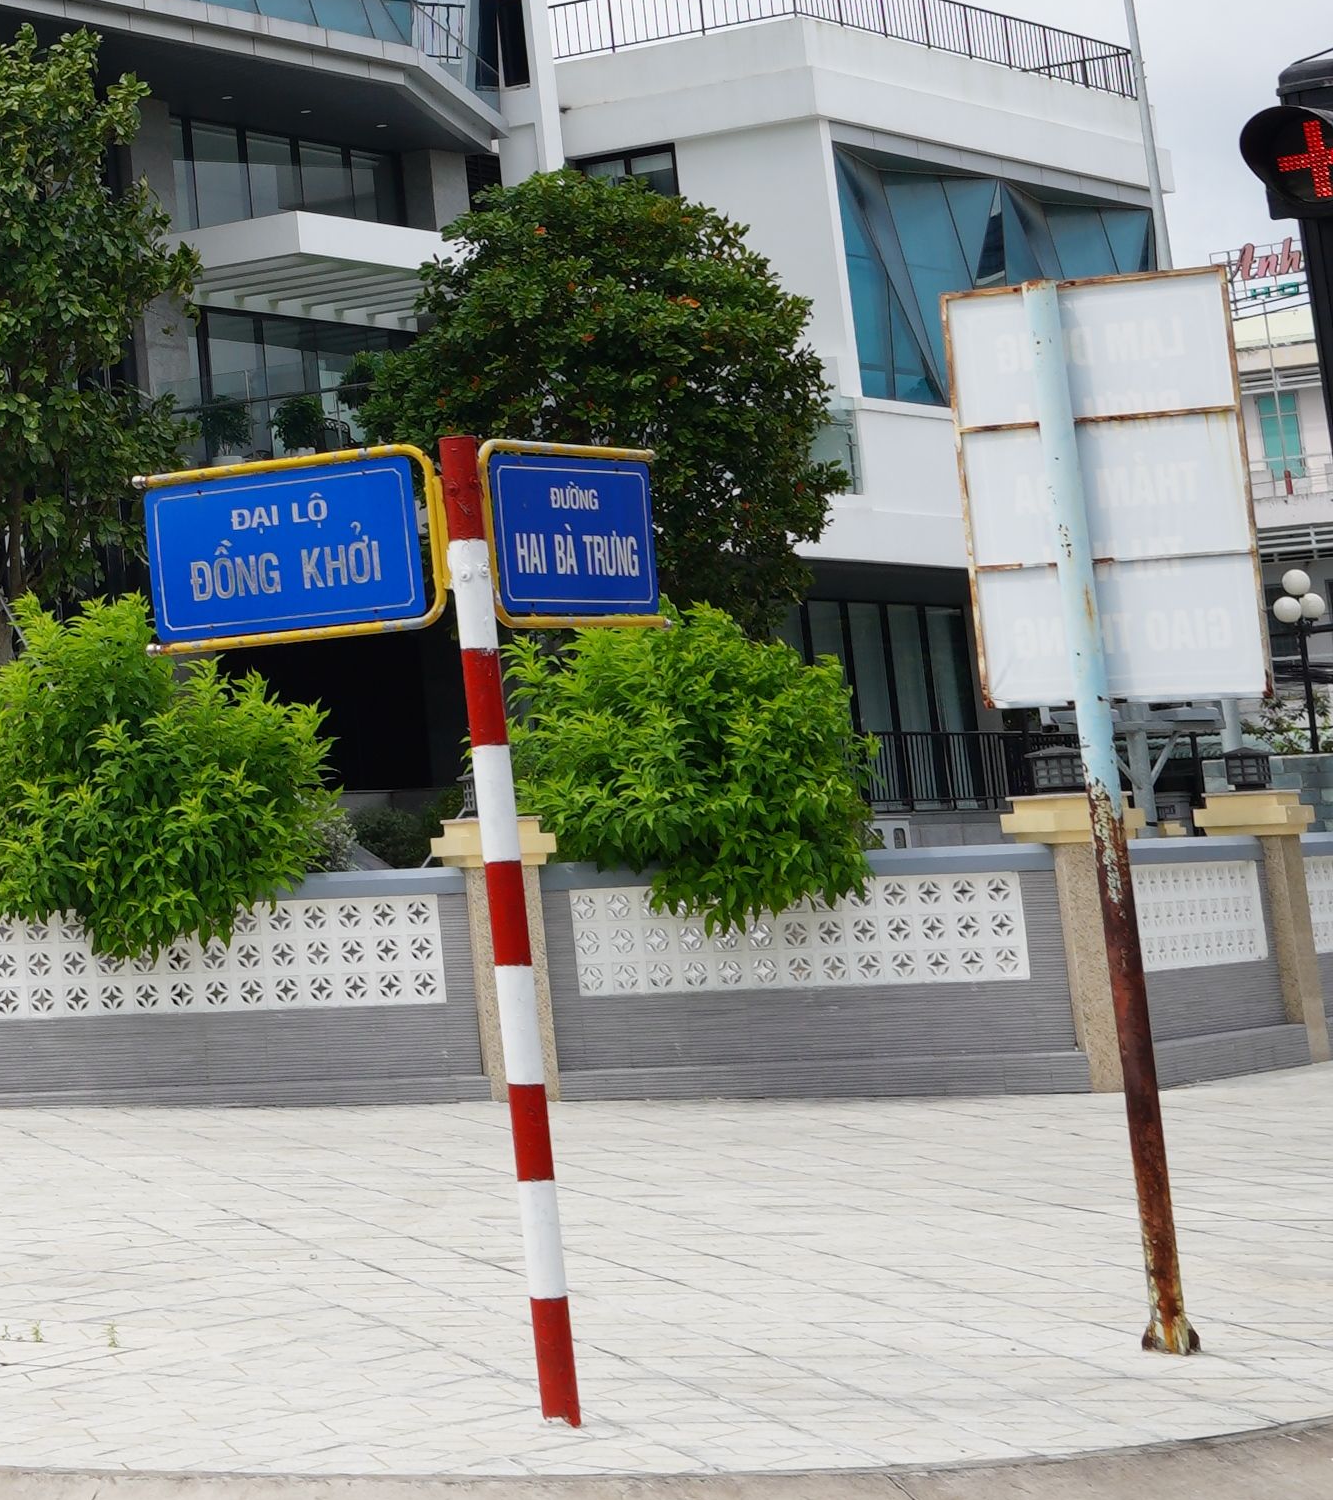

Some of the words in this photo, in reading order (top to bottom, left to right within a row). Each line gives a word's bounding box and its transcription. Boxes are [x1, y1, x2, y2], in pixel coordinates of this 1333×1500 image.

[1232, 237, 1301, 281] Anh
[231, 504, 279, 534] ĐẠI
[291, 492, 328, 528] LỘ
[550, 481, 599, 510] ĐƯỜNG
[190, 540, 282, 601] ĐỒNG
[300, 521, 382, 590] KHỞI
[515, 533, 547, 574] HAI
[554, 523, 579, 575] BÀ
[582, 531, 640, 577] TRƯNG
